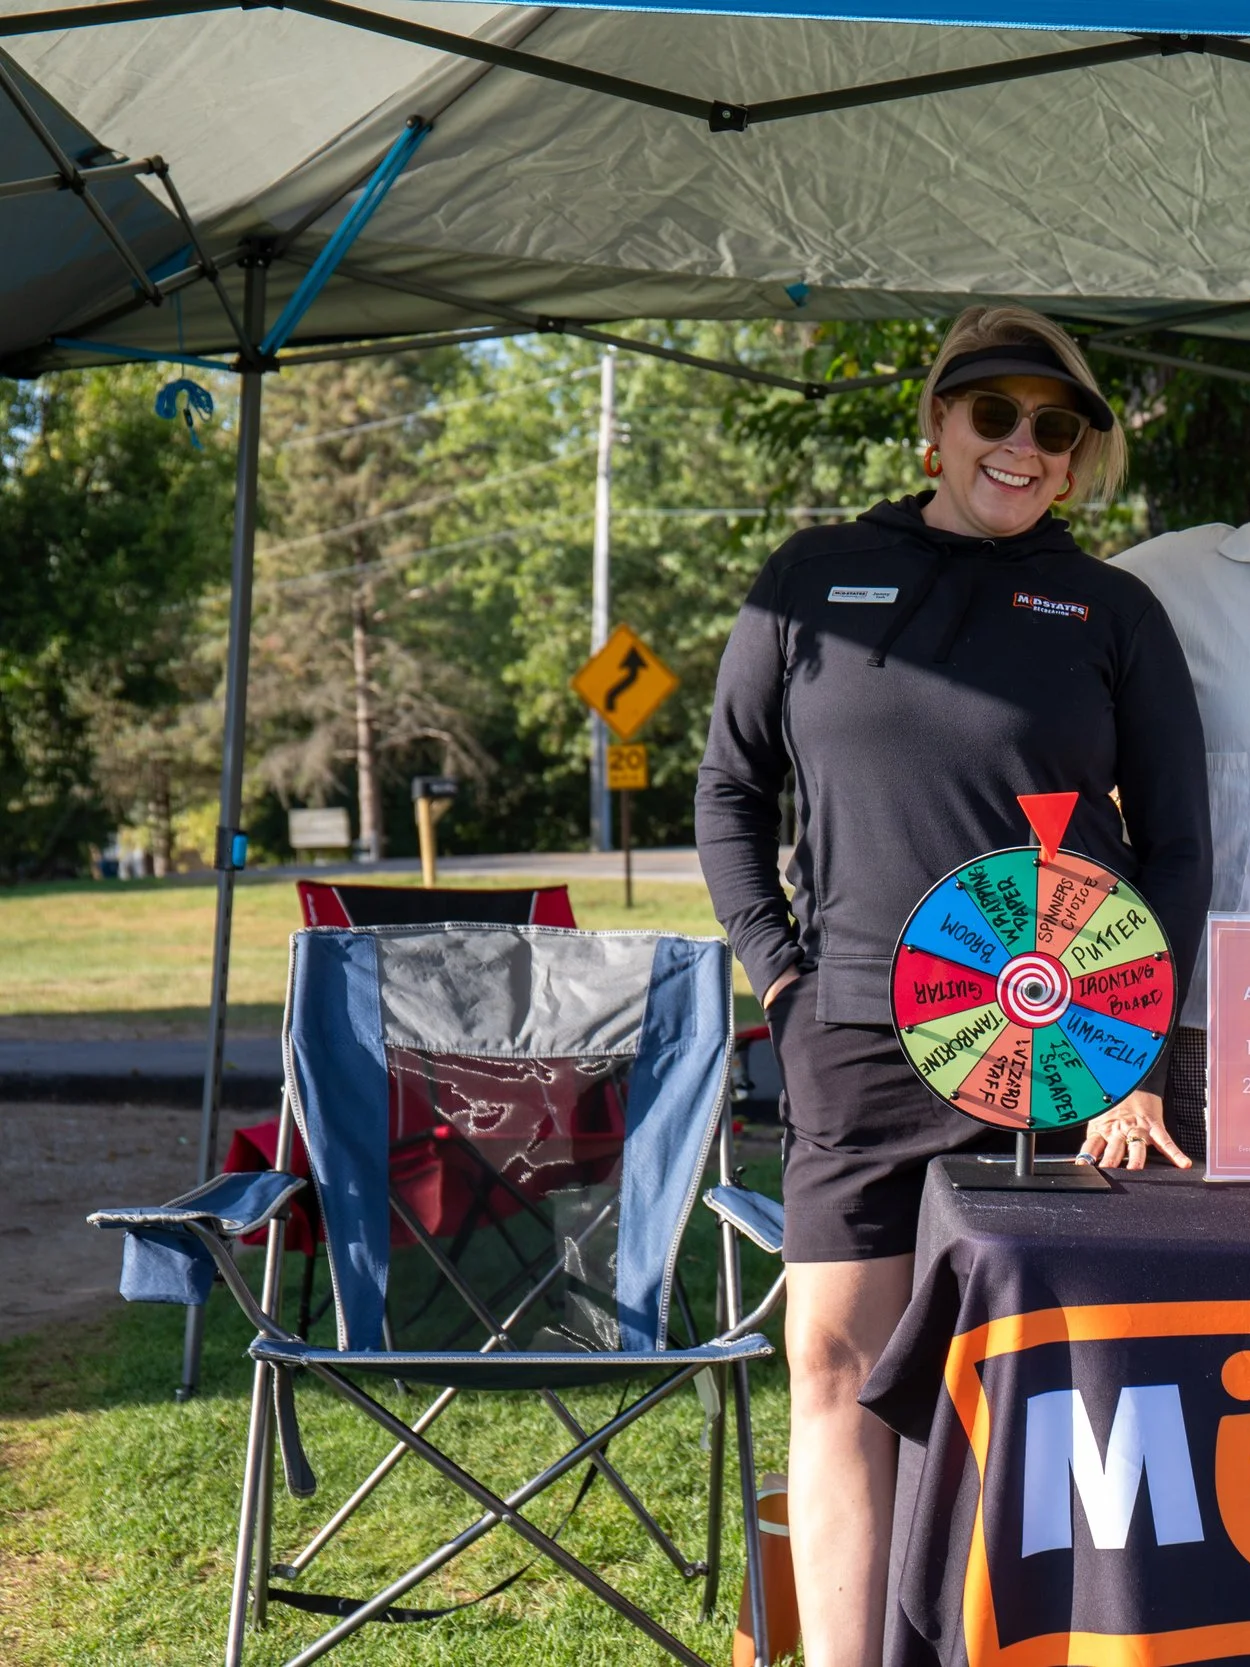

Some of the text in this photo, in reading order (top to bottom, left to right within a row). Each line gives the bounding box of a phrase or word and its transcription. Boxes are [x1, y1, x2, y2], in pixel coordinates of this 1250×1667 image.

[609, 749, 643, 770] 20
[967, 864, 1020, 946] WRAPPING
[997, 875, 1029, 932] PAPER
[1038, 877, 1075, 943] SPINNERS
[1061, 875, 1099, 930] CHOICE
[940, 912, 997, 964] BROOM
[1071, 908, 1147, 970] PUTTER
[913, 980, 983, 1004] GUITAR
[1079, 964, 1154, 997] IRONING
[1107, 989, 1163, 1016] BOARD
[918, 1009, 1004, 1077] TAMBORINE
[1050, 1039, 1083, 1069] ICE
[979, 1055, 1008, 1105] STAFF
[1000, 1039, 1031, 1110] WIZARD
[1039, 1054, 1078, 1123] SCRAPER
